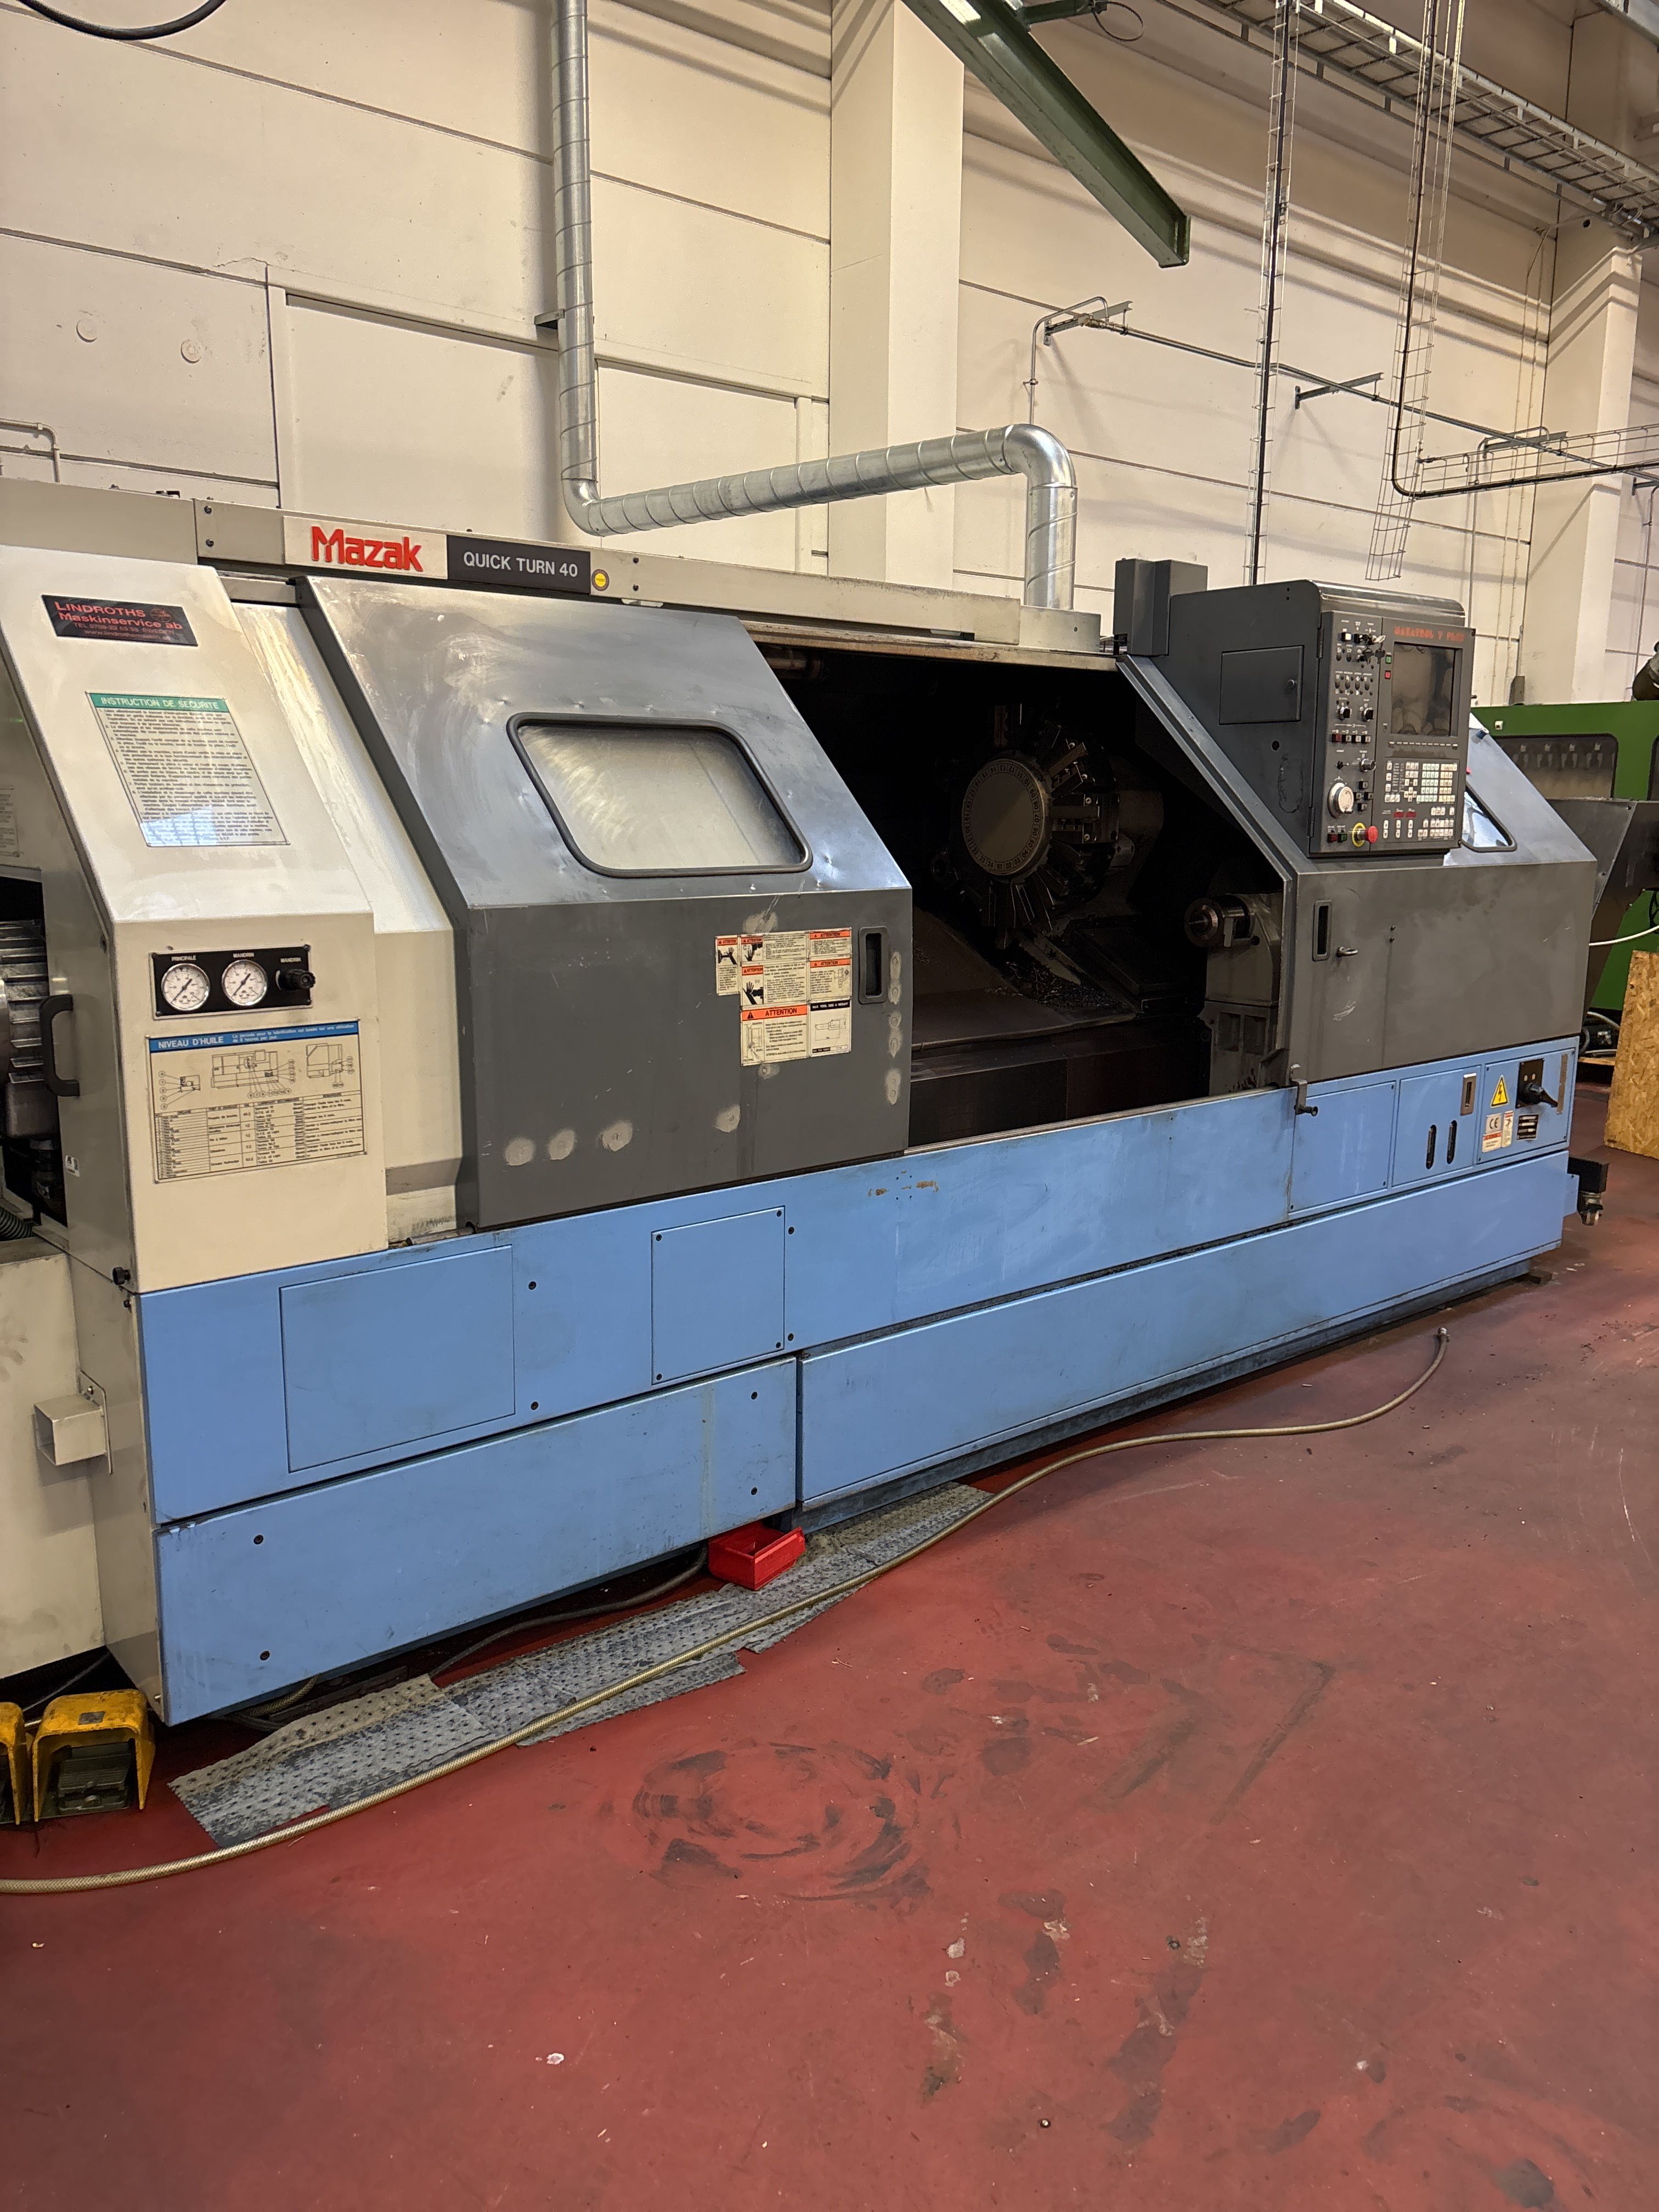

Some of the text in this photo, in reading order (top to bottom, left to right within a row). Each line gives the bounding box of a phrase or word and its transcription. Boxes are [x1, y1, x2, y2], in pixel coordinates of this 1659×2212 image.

[311, 526, 424, 572] Mazak
[464, 551, 578, 578] QUICK TURN 40
[55, 601, 146, 618] LINDROTHS
[59, 612, 183, 630] Maskinservice ab
[100, 697, 160, 707] INSTRUCTION
[765, 1008, 797, 1017] ATTENTION
[158, 1039, 189, 1049] NIVEAU
[193, 1036, 224, 1046] D'HUILE
[1489, 1117, 1499, 1130] CE
